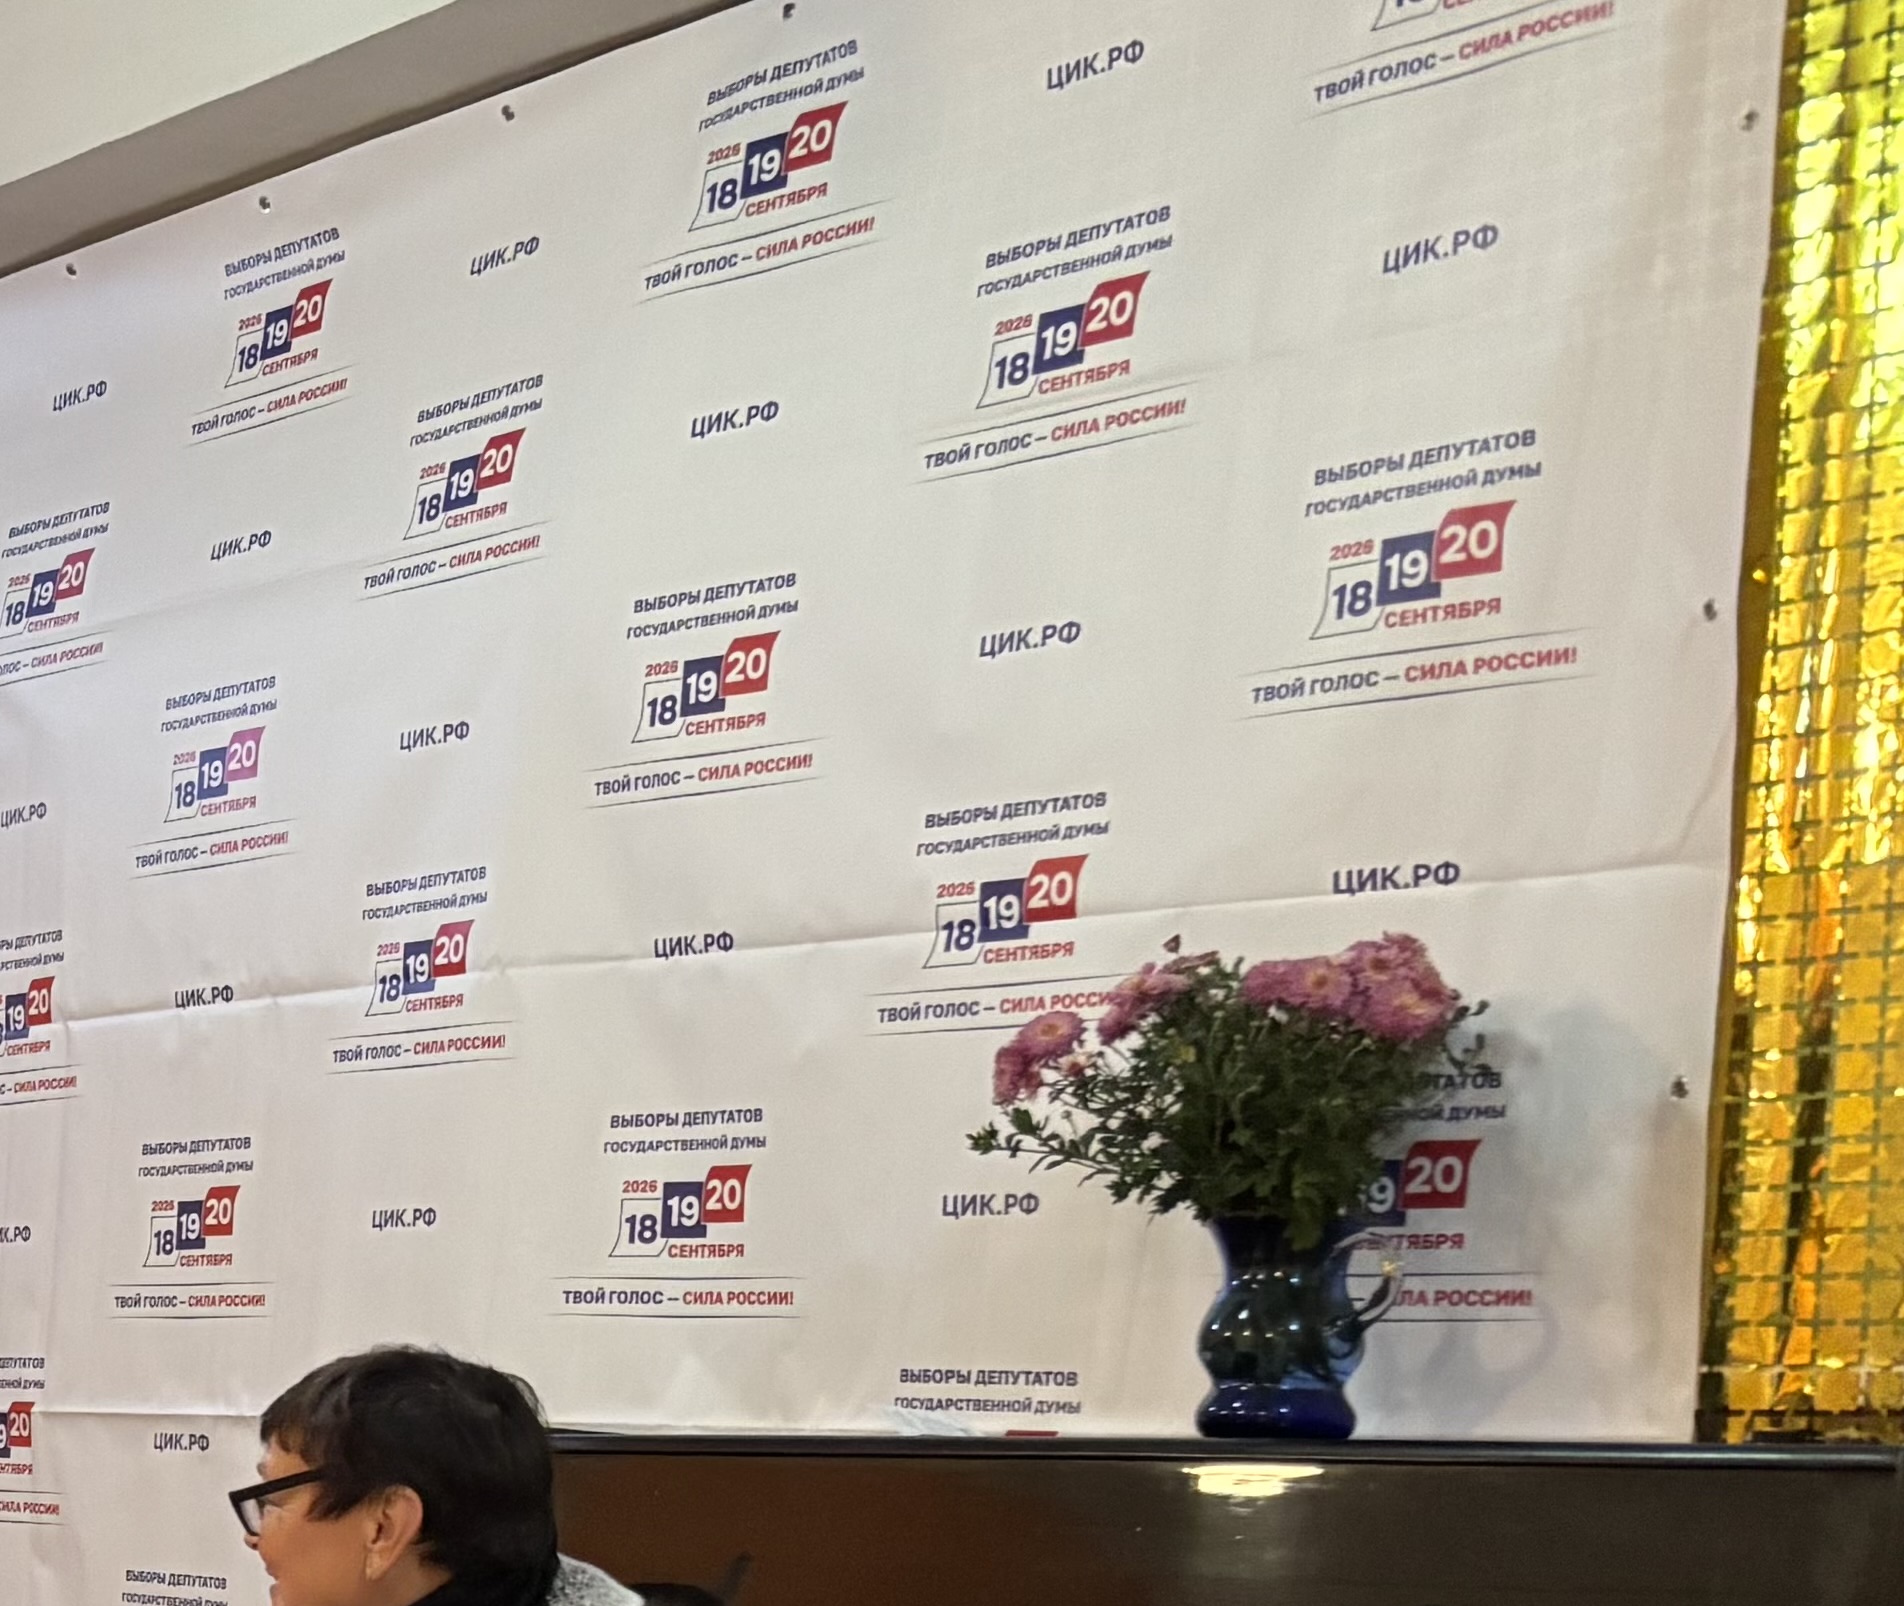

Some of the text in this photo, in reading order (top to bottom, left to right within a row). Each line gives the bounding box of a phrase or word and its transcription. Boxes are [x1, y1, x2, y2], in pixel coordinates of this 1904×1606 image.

[1047, 39, 1144, 90] ЦИК.РФ
[1314, 1, 1615, 102] ТВОЙ ГОЛОС СИЛА РОССИИ!
[707, 39, 858, 105] ВЫБОРЫ ДЕПУТАТОВ
[698, 67, 864, 132] ГОСУДАРСТВЕННОЙ ДУМЫ
[707, 119, 831, 213] 18 19 20
[745, 182, 828, 217] СЕНТЯБРЯ
[469, 235, 540, 277] ЦИК.РФ
[644, 216, 875, 290] ТВОЙ ГОЛОС СИЛА РОССИИ!
[986, 205, 1171, 269] ВЫБОРЫ ДЕПУТАТОВ
[1382, 224, 1499, 274] ЦИК.РФ
[976, 234, 1173, 298] ГОСУДАРСТВЕННОЙ ДУМЫ
[238, 295, 322, 372] 18 19 20
[995, 291, 1133, 389] 18 19 20
[53, 380, 107, 411] ЦИК.РФ
[1038, 359, 1130, 394] СЕНТЯБРЯ
[417, 374, 543, 423] ВЫБОРЫ ДЕПУТАТОВ
[410, 398, 543, 447] ГОСУДАРСТВЕННОЙ ДУМЫ
[690, 400, 779, 439] ЦИК.РФ
[924, 398, 1186, 469] ТВОЙ ГОЛОС СИЛА РОССИИ!
[1314, 429, 1533, 486] ВЫБОРЫ ДЕПУТАТОВ
[418, 444, 513, 524] 18 19 20
[1304, 462, 1539, 518] ГОСУДАРСТВЕННОЙ ДУМЫ
[445, 501, 508, 529] СЕНТЯБРЯ
[210, 530, 272, 561] ЦИК.РФ
[364, 535, 540, 590] ТВОЙ ГОЛОС СИЛА РОССИИ!
[1324, 520, 1496, 620] 18 19 20
[634, 573, 796, 613] ВЫБОРЫ ДЕПУТАТОВ
[1385, 597, 1500, 628] СЕНТЯБРЯ
[626, 600, 798, 640] ГОСУДАРСТВЕННОЙ ДУМЫ
[979, 621, 1082, 659] ЦИК.РФ
[642, 648, 766, 727] 18 19 20
[1251, 647, 1574, 704] ТВОЙ ГОЛОС СИЛА РОССИИ!
[399, 720, 470, 753] ЦИК.РФ
[685, 712, 765, 736] СЕНТЯБРЯ
[170, 740, 255, 809] 18 19 20
[594, 754, 811, 796] ТВОЙ ГОЛОС СИЛА РОССИИ!
[925, 791, 1106, 829] ВЫБОРЫ ДЕПУТАТОВ
[916, 821, 1108, 857] ГОСУДАРСТВЕННОЙ ДУМЫ
[1333, 860, 1461, 896] ЦИК.РФ
[937, 871, 1072, 952] 18 19 20
[654, 931, 734, 959] ЦИК.РФ
[985, 941, 1074, 964] СЕНТЯБРЯ
[375, 934, 463, 1003] 18 19 20
[7, 1005, 24, 1031] 19
[28, 988, 48, 1015] 20
[174, 985, 233, 1009] ЦИК.РФ
[405, 993, 464, 1013] СЕНТЯБРЯ
[877, 1002, 920, 1023] ТВОЙ
[923, 1001, 980, 1019] ГОЛОС
[1000, 995, 1046, 1014] СИЛА
[610, 1108, 763, 1129] ВЫБОРЫ ДЕПУТАТОВ
[1444, 1105, 1506, 1121] ДУМЫ
[604, 1134, 766, 1154] ГОСУДАРСТВЕННОЙ ДУМЫ
[1404, 1155, 1463, 1194] 20
[371, 1207, 437, 1232] ЦИК.РФ
[625, 1179, 741, 1244] 18 19 20
[942, 1192, 1039, 1220] ЦИК.РФ
[154, 1198, 231, 1256] 18 19 20
[180, 1253, 232, 1267] СЕНТЯБРЯ
[668, 1243, 745, 1258] СЕНТЯБРЯ
[562, 1287, 793, 1305] ТВОЙ ГОЛОС СИЛА РОССИИ!
[1433, 1290, 1533, 1306] РОССИИ!
[899, 1368, 1079, 1386] ВЫБОРЫ ДЕПУТАТОВ
[894, 1397, 1081, 1414] ГОСУДАРСТВЕННОЙ ДУМЫ
[153, 1432, 209, 1451] ЦИК.РФ
